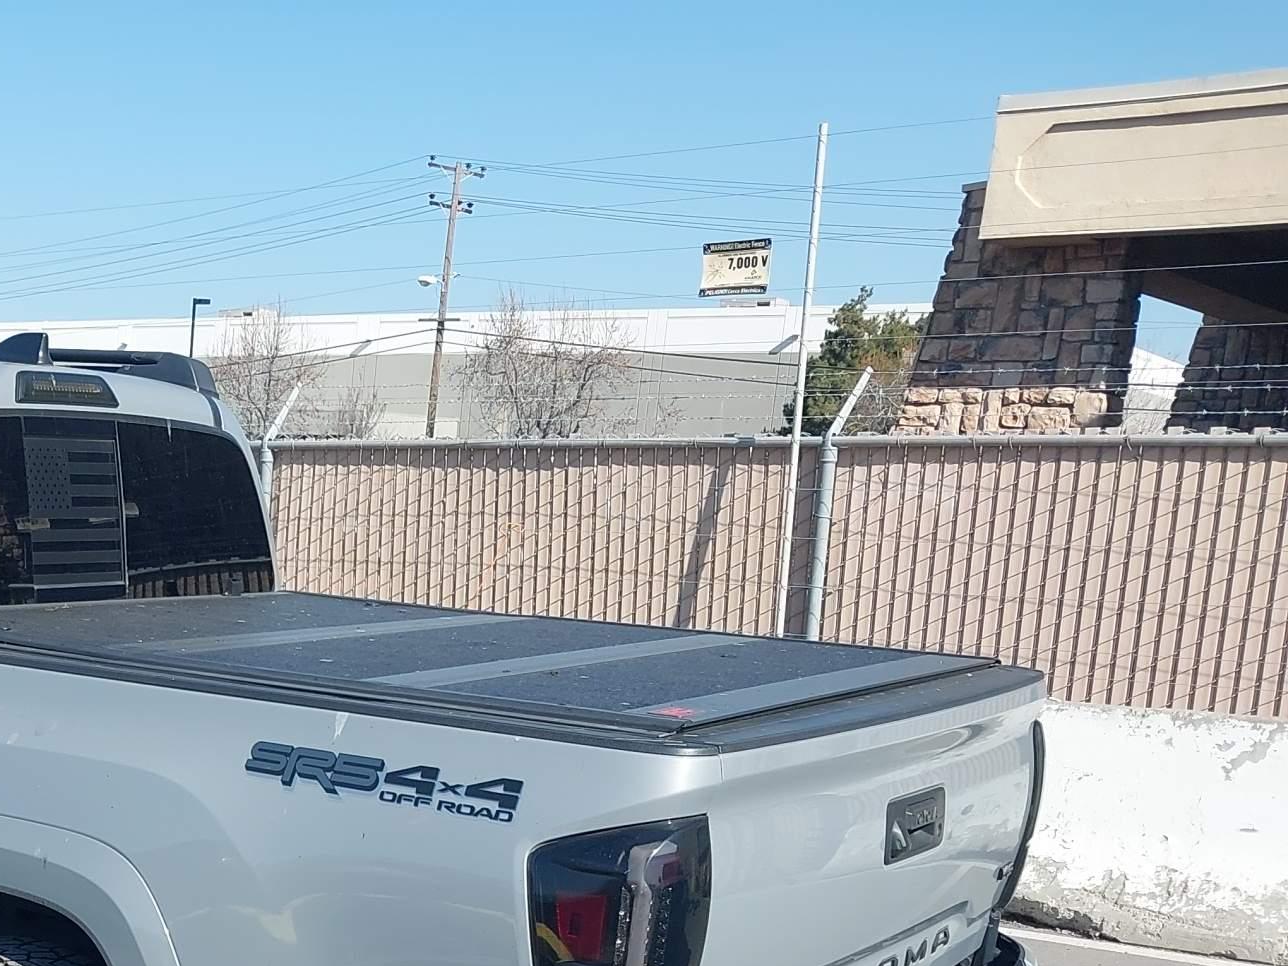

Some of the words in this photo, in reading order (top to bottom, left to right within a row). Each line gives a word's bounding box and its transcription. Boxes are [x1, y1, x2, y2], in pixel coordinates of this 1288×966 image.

[728, 256, 758, 271] 7,000
[761, 254, 769, 267] V
[244, 740, 386, 795] SR5
[378, 790, 433, 808] OFF
[436, 799, 514, 823] ROAD
